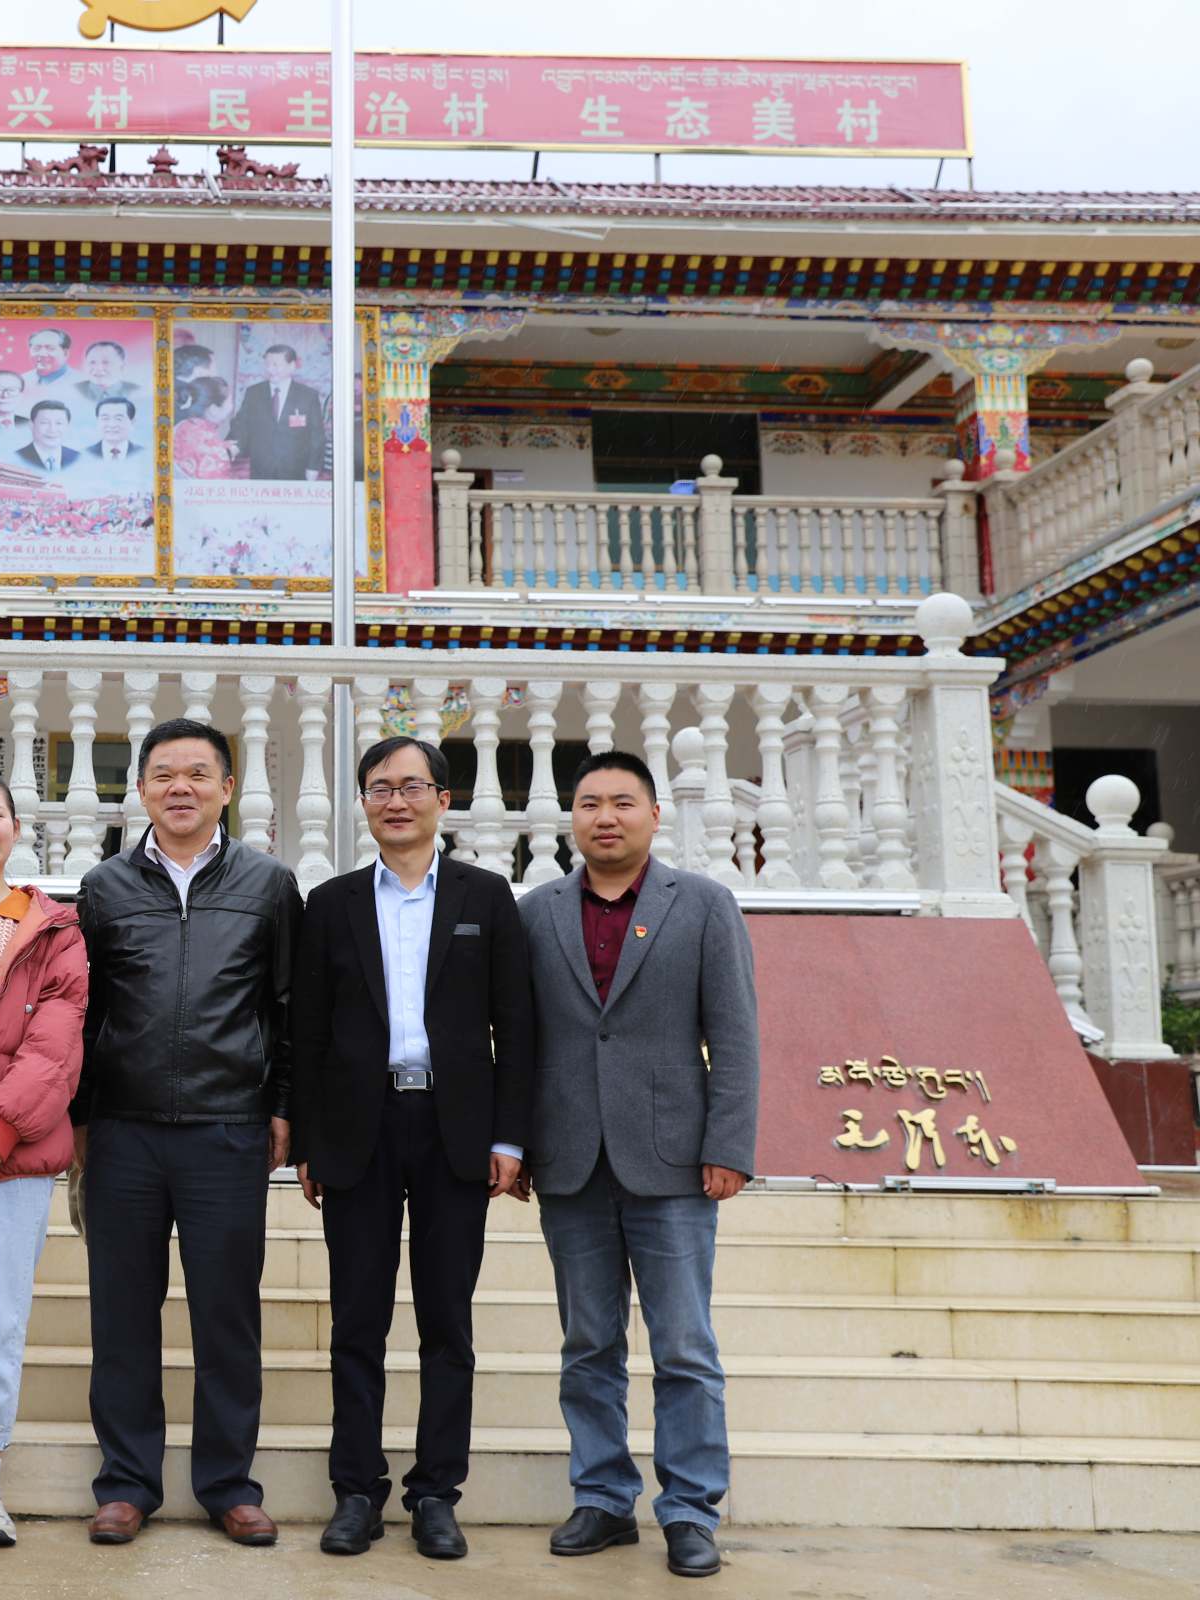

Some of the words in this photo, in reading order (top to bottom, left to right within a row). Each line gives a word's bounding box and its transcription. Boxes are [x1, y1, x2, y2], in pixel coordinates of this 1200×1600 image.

[208, 90, 488, 138] 民主治村
[579, 96, 882, 143] 生态美村
